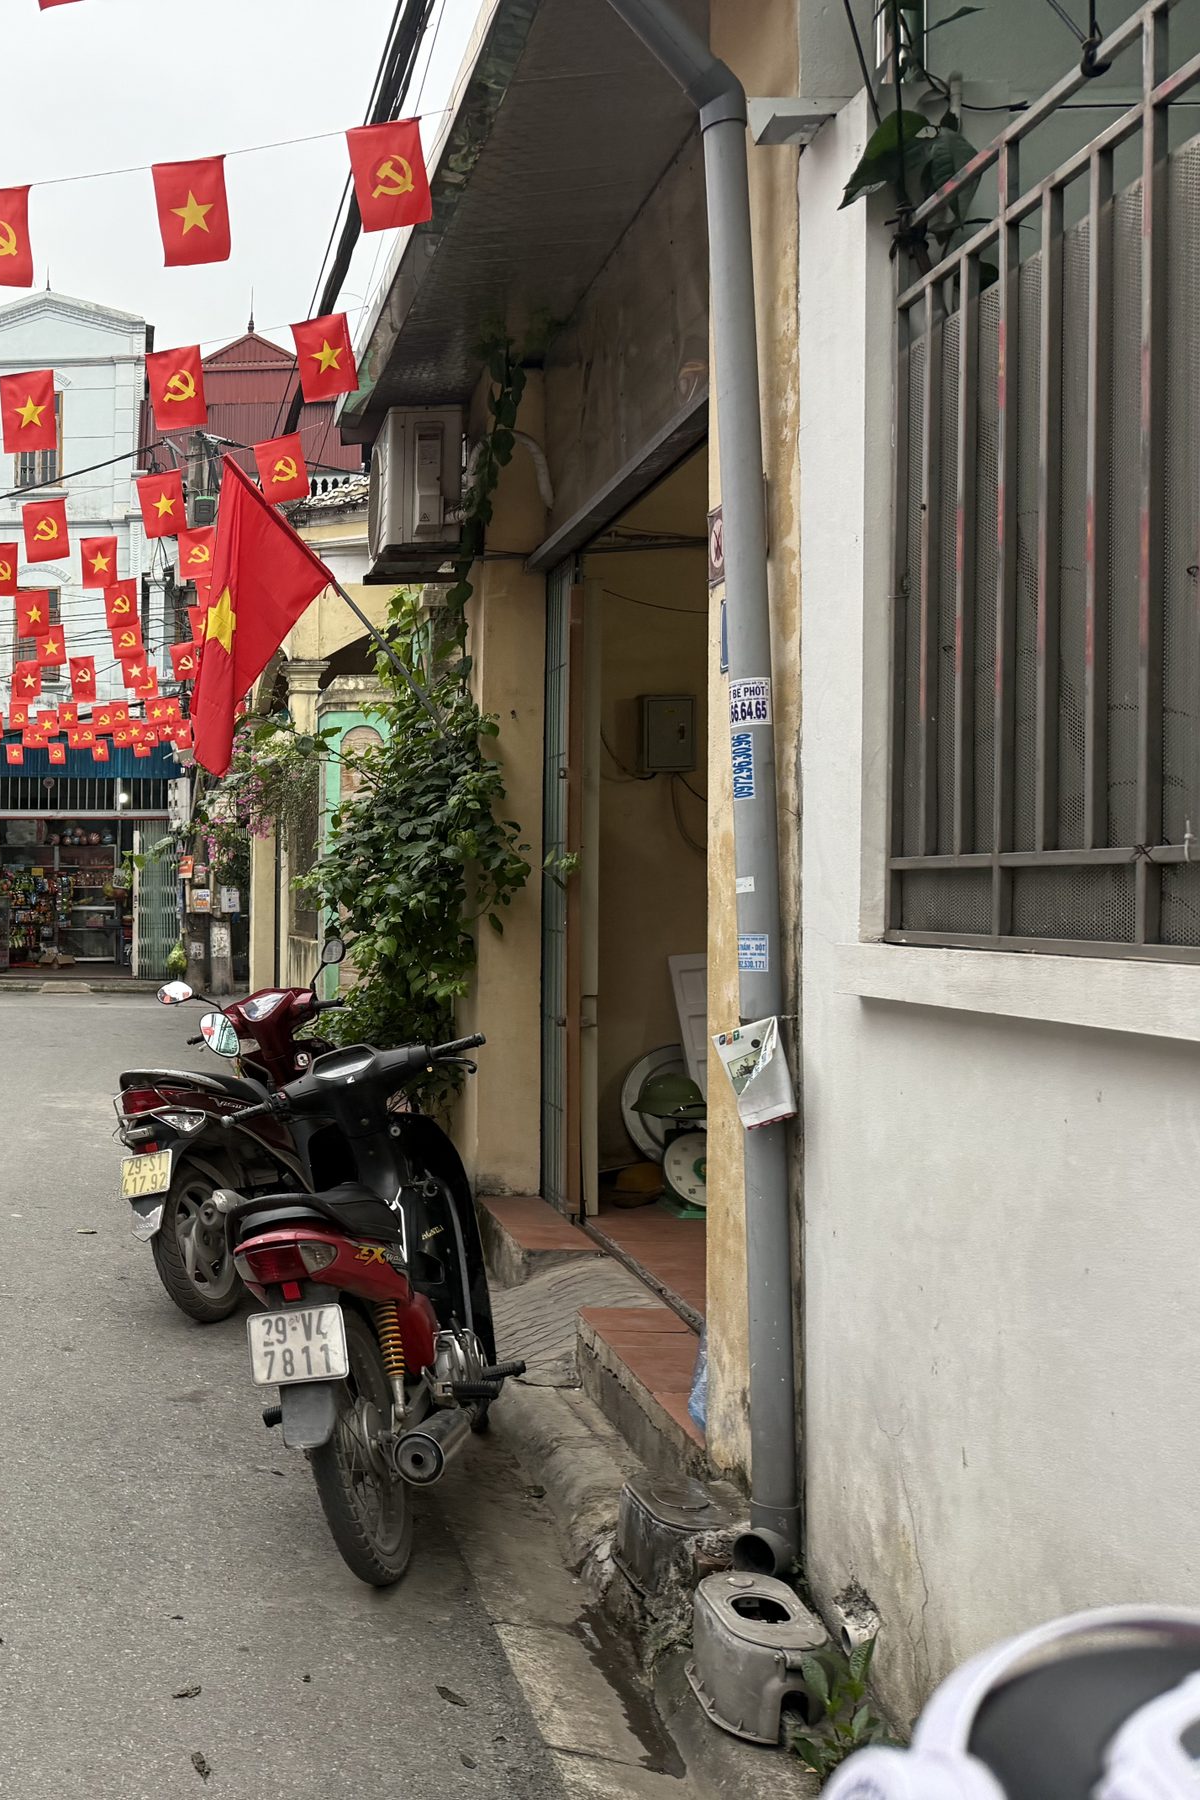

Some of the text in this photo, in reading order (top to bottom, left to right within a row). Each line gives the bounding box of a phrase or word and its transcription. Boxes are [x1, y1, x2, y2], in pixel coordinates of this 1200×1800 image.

[732, 733, 753, 799] 0972.96.30.96
[128, 1154, 162, 1176] 29-S1
[263, 1343, 331, 1380] 7811
